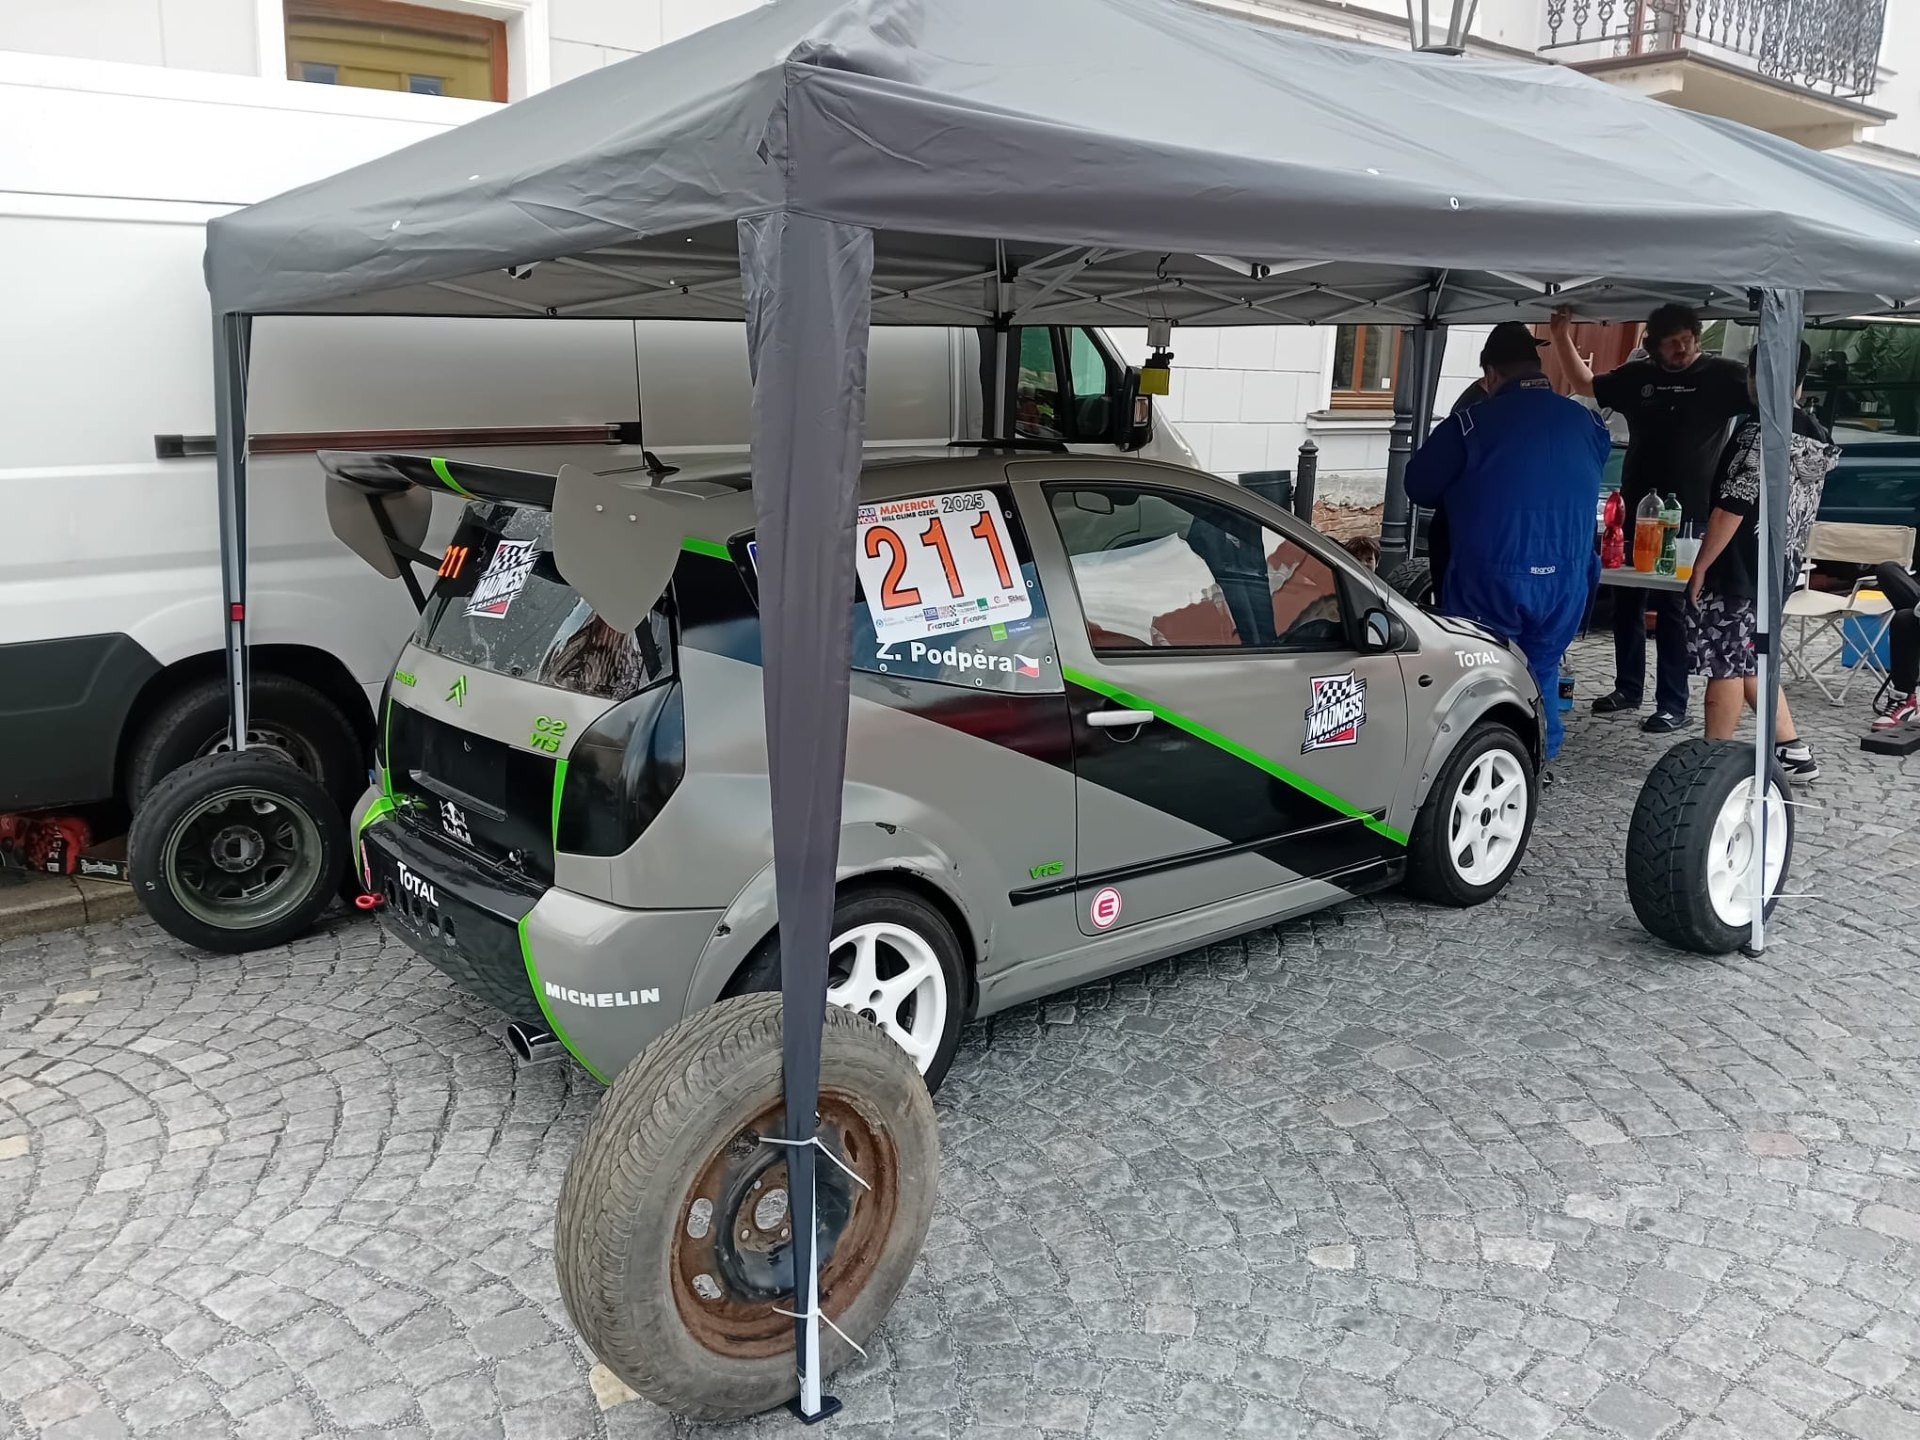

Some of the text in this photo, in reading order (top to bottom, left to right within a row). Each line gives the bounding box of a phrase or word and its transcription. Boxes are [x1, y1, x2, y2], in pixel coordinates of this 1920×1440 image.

[858, 508, 876, 516] IQUI
[880, 499, 936, 515] MAVERICK
[941, 493, 985, 513] 2025
[437, 545, 469, 578] 211
[865, 510, 1014, 611] 211
[876, 641, 1013, 673] Z. Podpěra
[1308, 690, 1364, 740] MADNESS
[535, 715, 567, 737] C2
[1319, 722, 1353, 743] RACING
[530, 733, 561, 753] VTS
[1029, 860, 1064, 879] VTS
[545, 981, 660, 1008] MICHELIN
